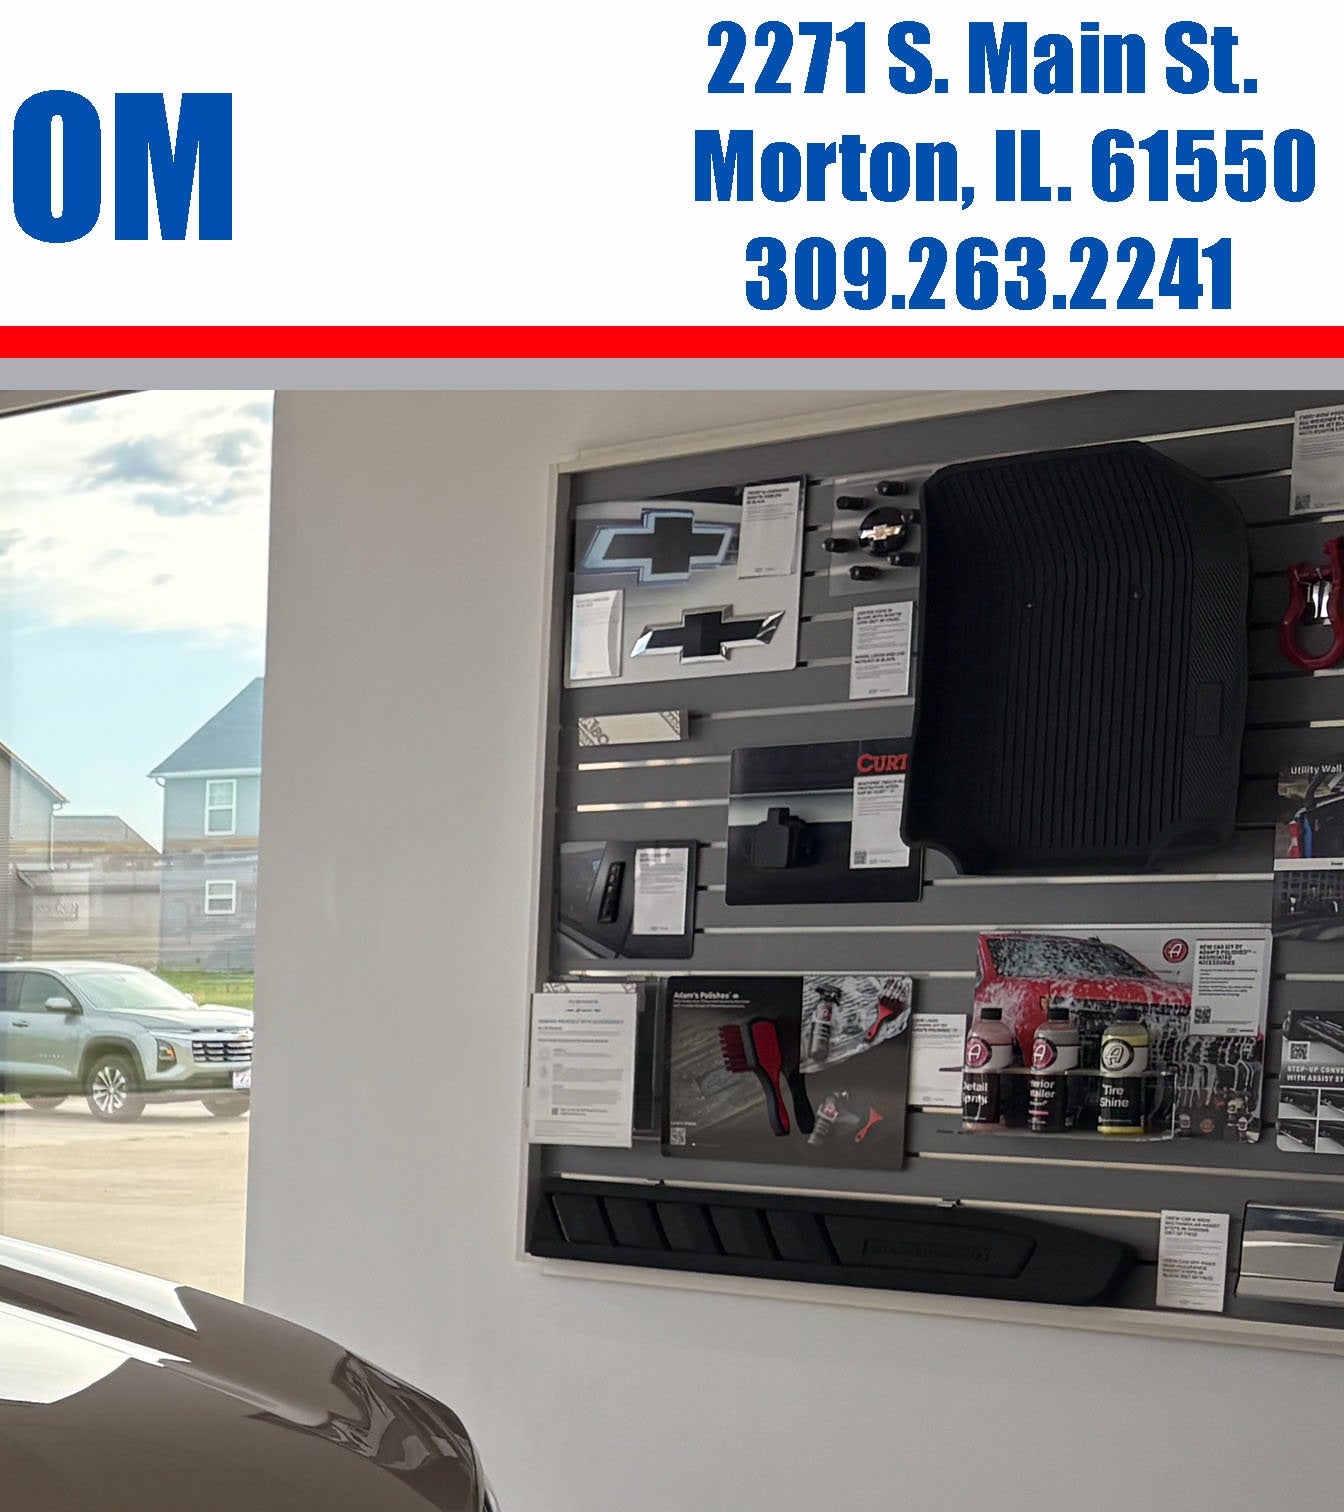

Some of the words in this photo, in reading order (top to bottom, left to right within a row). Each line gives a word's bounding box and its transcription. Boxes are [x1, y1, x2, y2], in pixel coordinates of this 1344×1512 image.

[1290, 765, 1320, 775] Utility
[1321, 764, 1343, 773] Wall
[1287, 1065, 1319, 1073] STEP-UP
[1102, 1084, 1124, 1096] Tire
[1099, 1097, 1129, 1108] Shine
